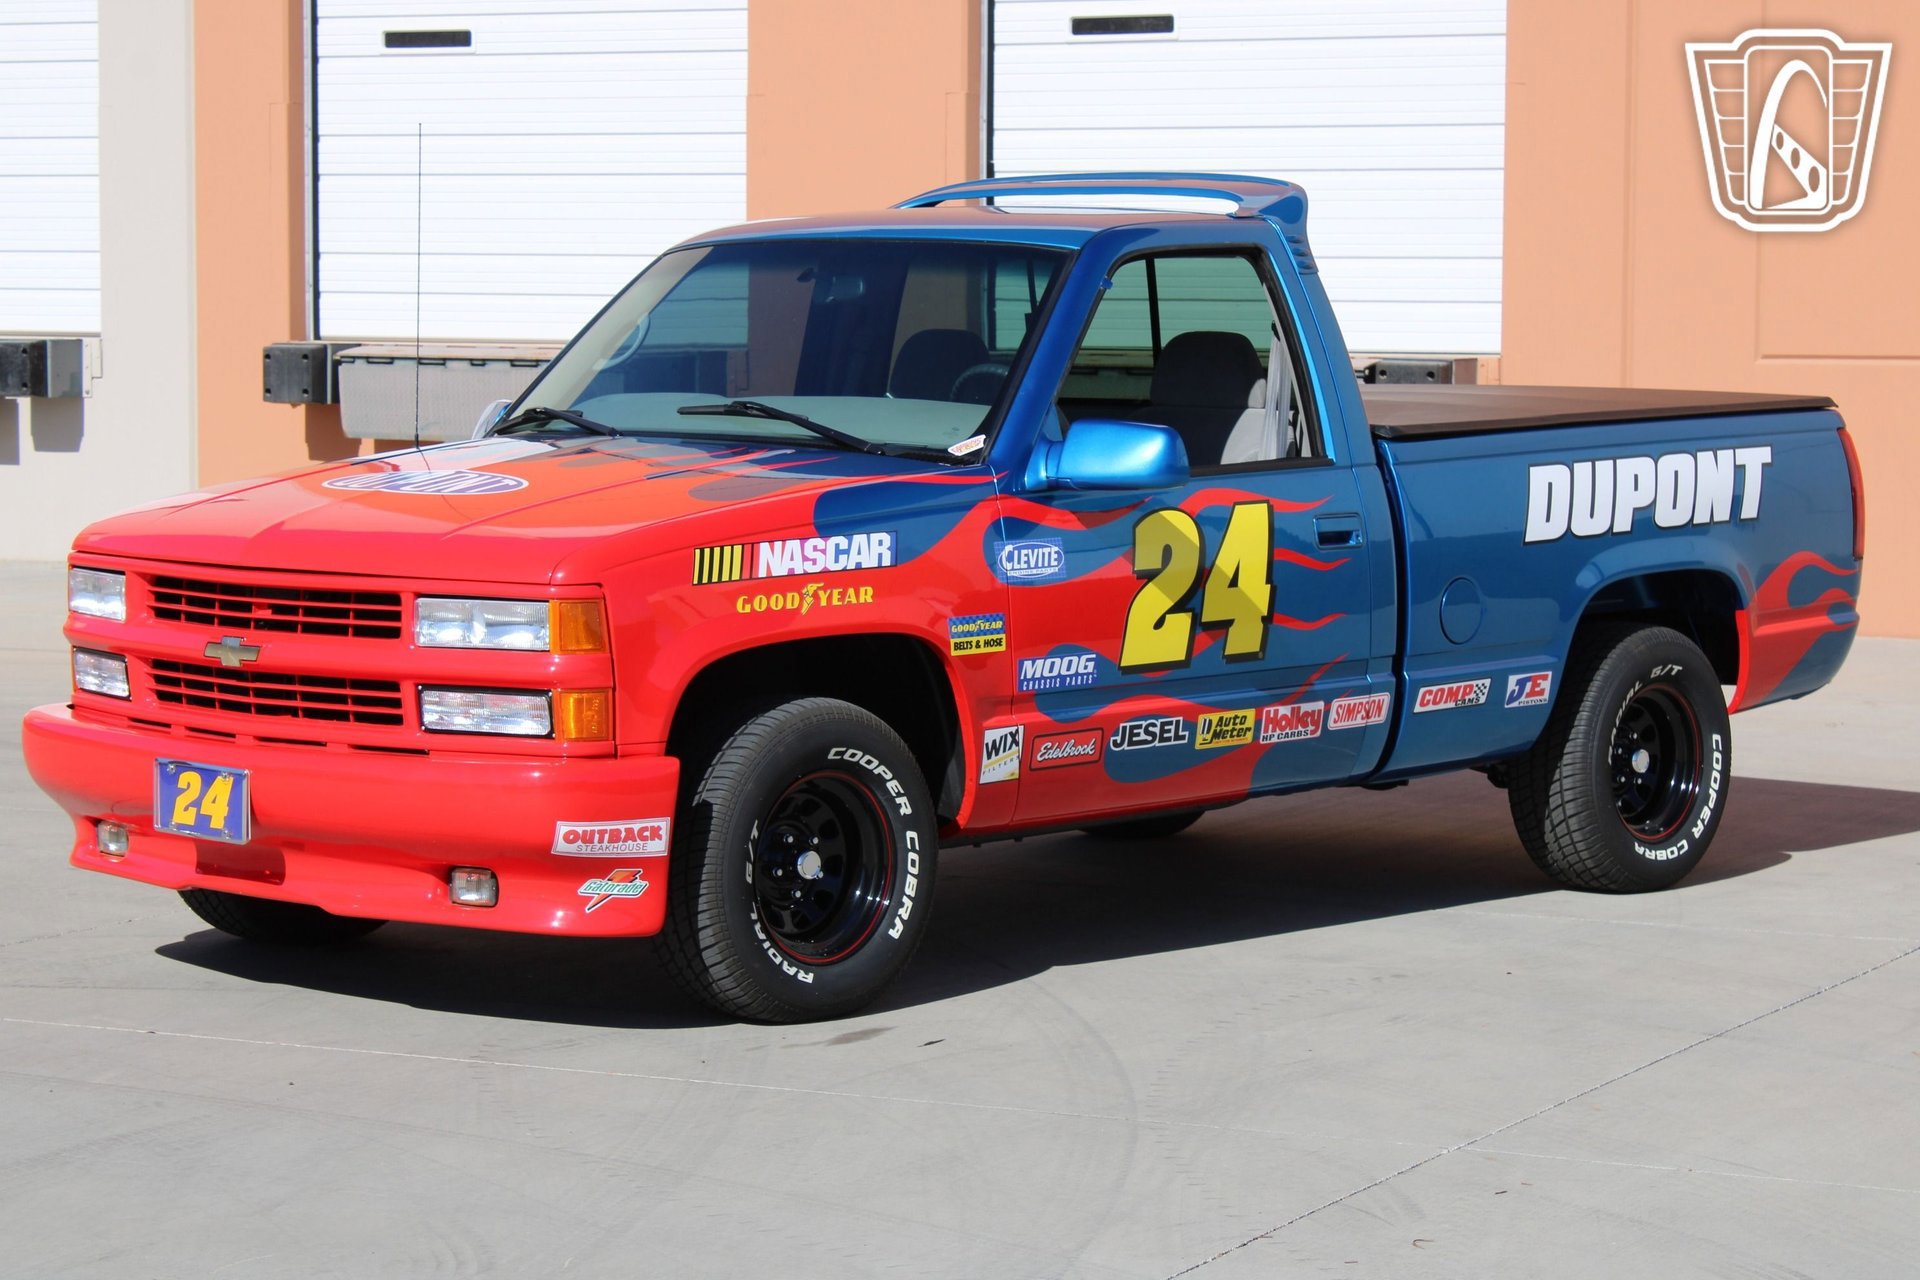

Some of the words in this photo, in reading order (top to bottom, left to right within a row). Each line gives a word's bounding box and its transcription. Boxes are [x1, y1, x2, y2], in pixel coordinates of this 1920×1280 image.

[1524, 445, 1773, 543] DUPONT
[757, 532, 892, 578] NASCAR
[1002, 545, 1059, 570] CLEVITE
[1118, 500, 1277, 676] 24
[953, 640, 973, 651] BELTS
[975, 638, 981, 649] &
[984, 637, 1003, 648] HOSE
[1020, 654, 1096, 680] MOOG
[1650, 664, 1682, 679] G/T
[1023, 677, 1060, 691] CHASSIS
[1065, 674, 1093, 686] PARTS
[1506, 673, 1549, 706] JE
[1419, 683, 1475, 708] COMP
[1454, 696, 1481, 707] CAMS
[1215, 714, 1247, 729] Auto
[1262, 705, 1323, 736] Holley
[1333, 698, 1385, 725] SIMPSON
[985, 727, 1019, 760] WIX
[1110, 717, 1189, 751] JESEL
[1212, 726, 1252, 742] Meter
[1262, 733, 1275, 742] HP
[1277, 729, 1309, 740] CARBS
[1036, 738, 1096, 763] Edelbrock
[1691, 733, 1722, 840] COOPER
[172, 770, 234, 829] 24
[562, 825, 663, 845] OUTBACK
[576, 842, 648, 852] STEAKHOUSE
[827, 747, 912, 816] COOPER
[888, 830, 919, 940] COBRA
[1634, 838, 1689, 861] COBRA
[584, 880, 643, 894] Gatorade
[750, 901, 814, 984] RADIAL
